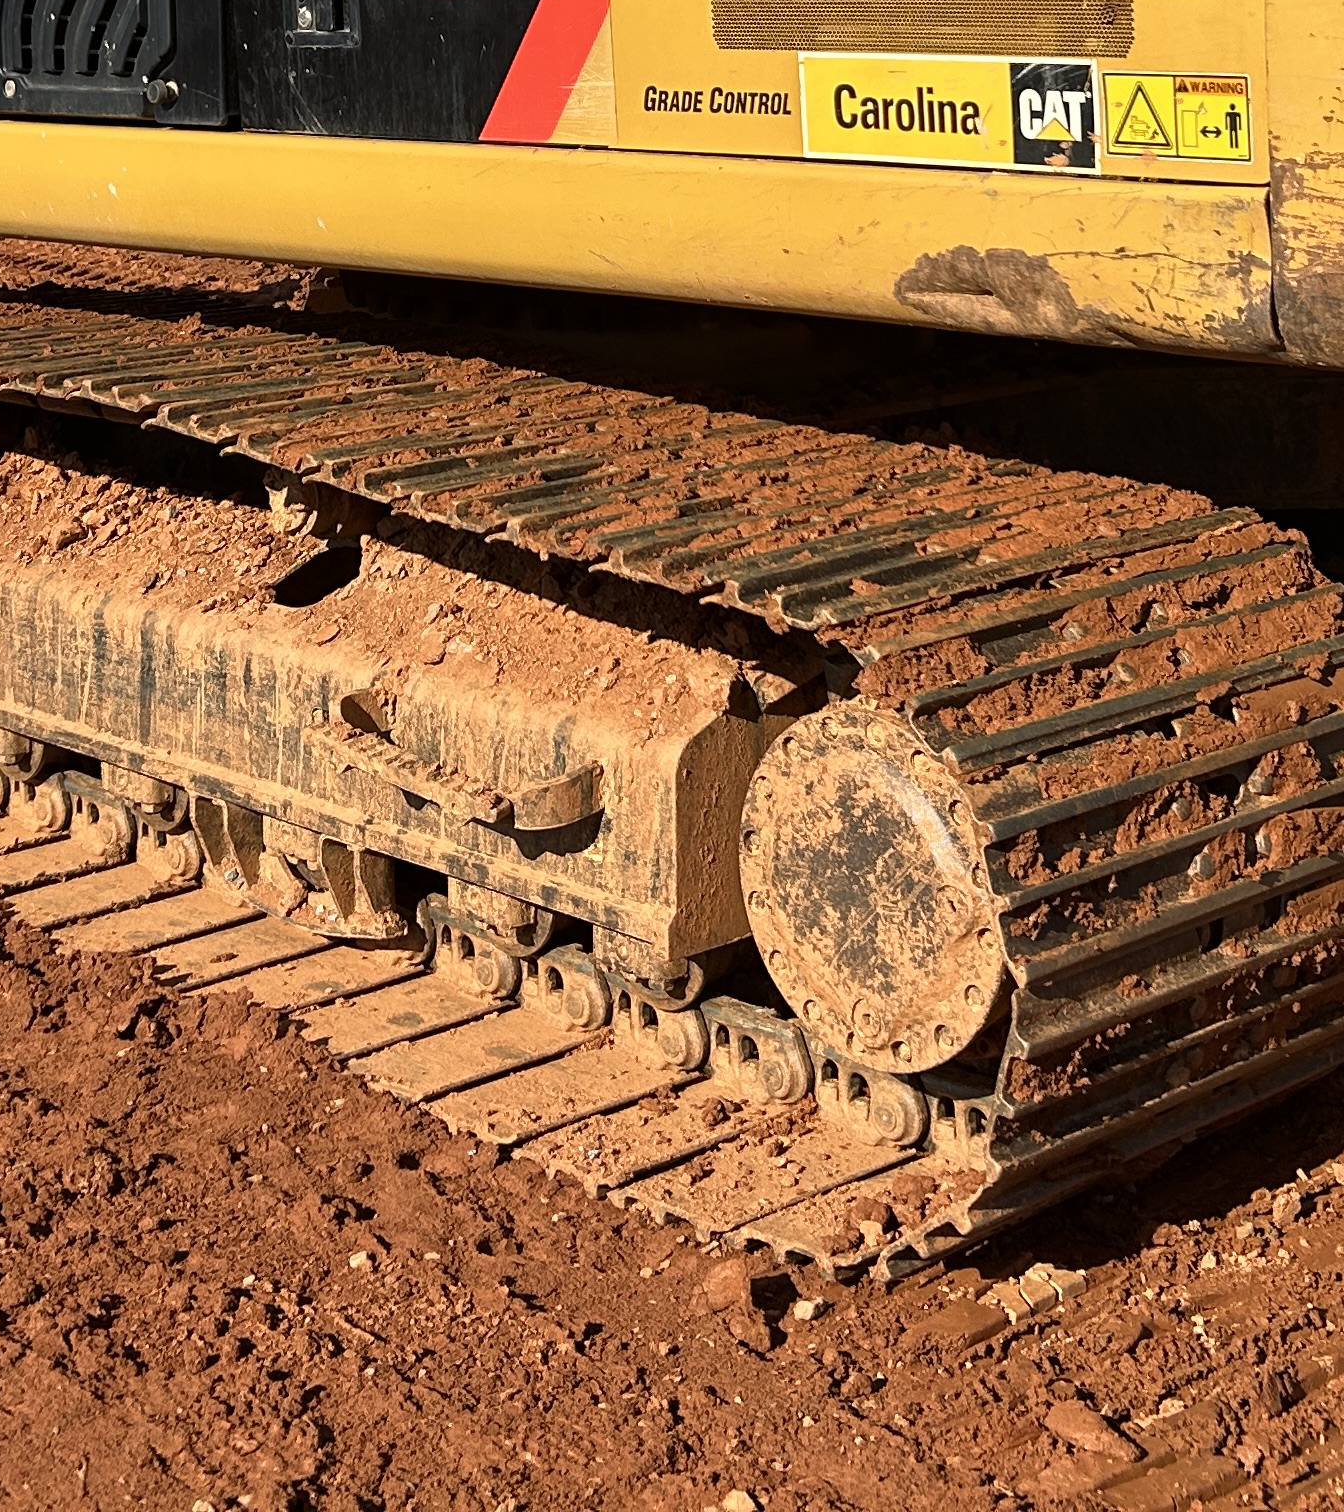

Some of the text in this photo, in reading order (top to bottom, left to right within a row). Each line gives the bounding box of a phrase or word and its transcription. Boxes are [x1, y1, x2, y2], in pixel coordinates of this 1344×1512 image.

[833, 83, 981, 135] Carolina
[1189, 81, 1244, 95] WARNING
[1018, 88, 1086, 141] CAT
